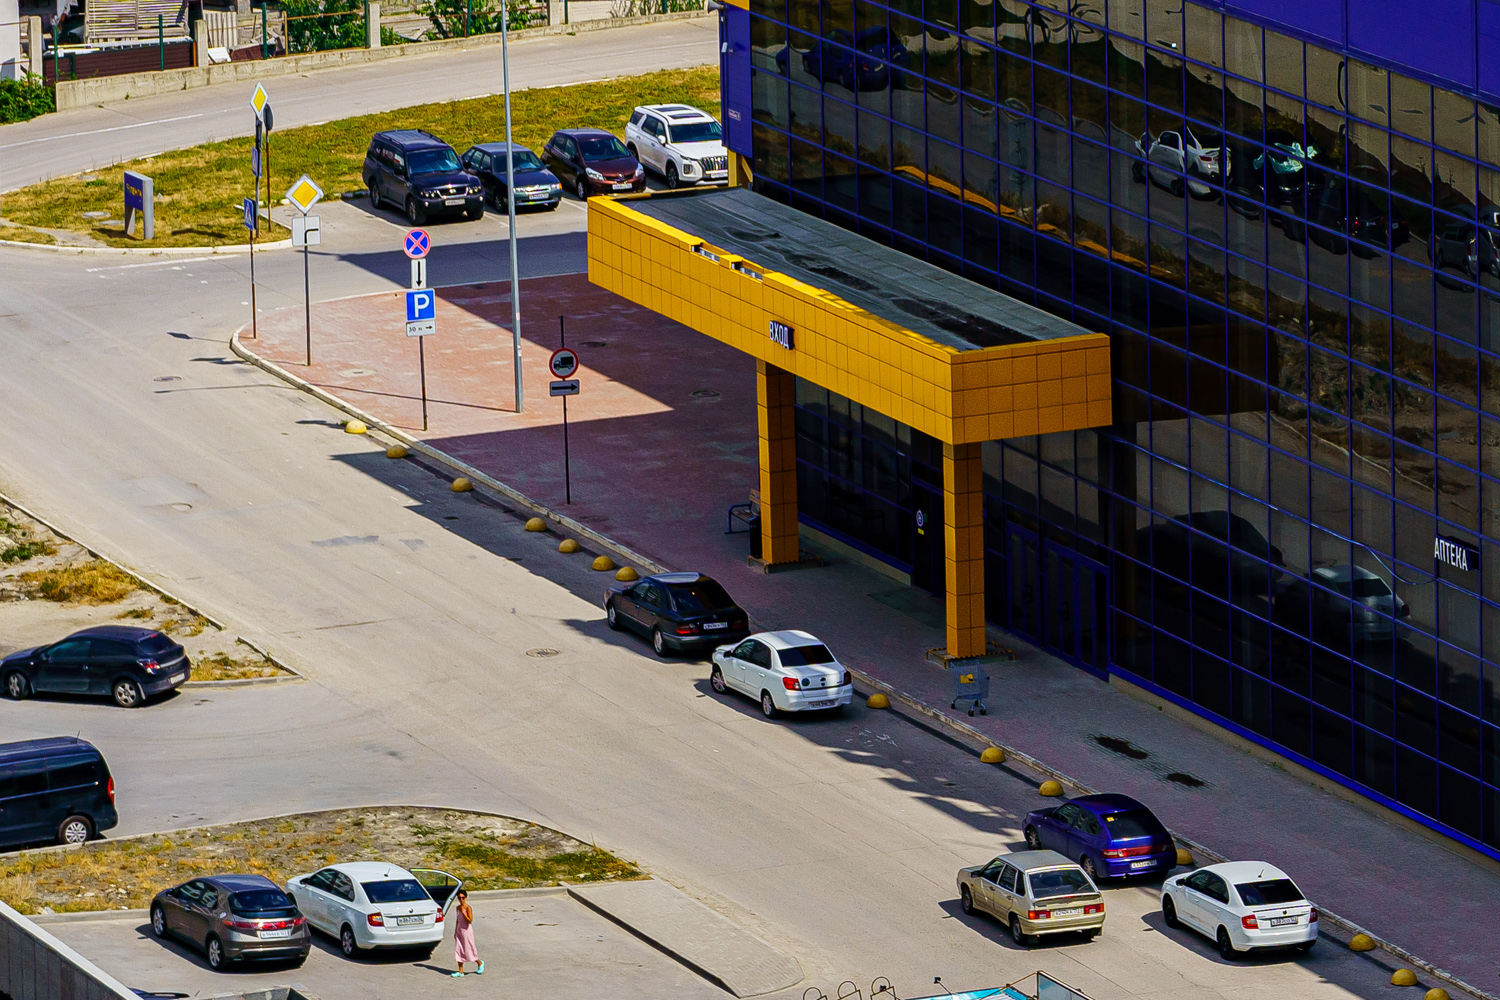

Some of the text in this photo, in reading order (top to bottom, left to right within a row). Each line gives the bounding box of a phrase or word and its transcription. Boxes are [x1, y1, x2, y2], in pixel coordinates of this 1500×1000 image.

[413, 293, 430, 318] P
[769, 320, 790, 351] ВХОД
[1434, 537, 1469, 571] АПТЕКА
